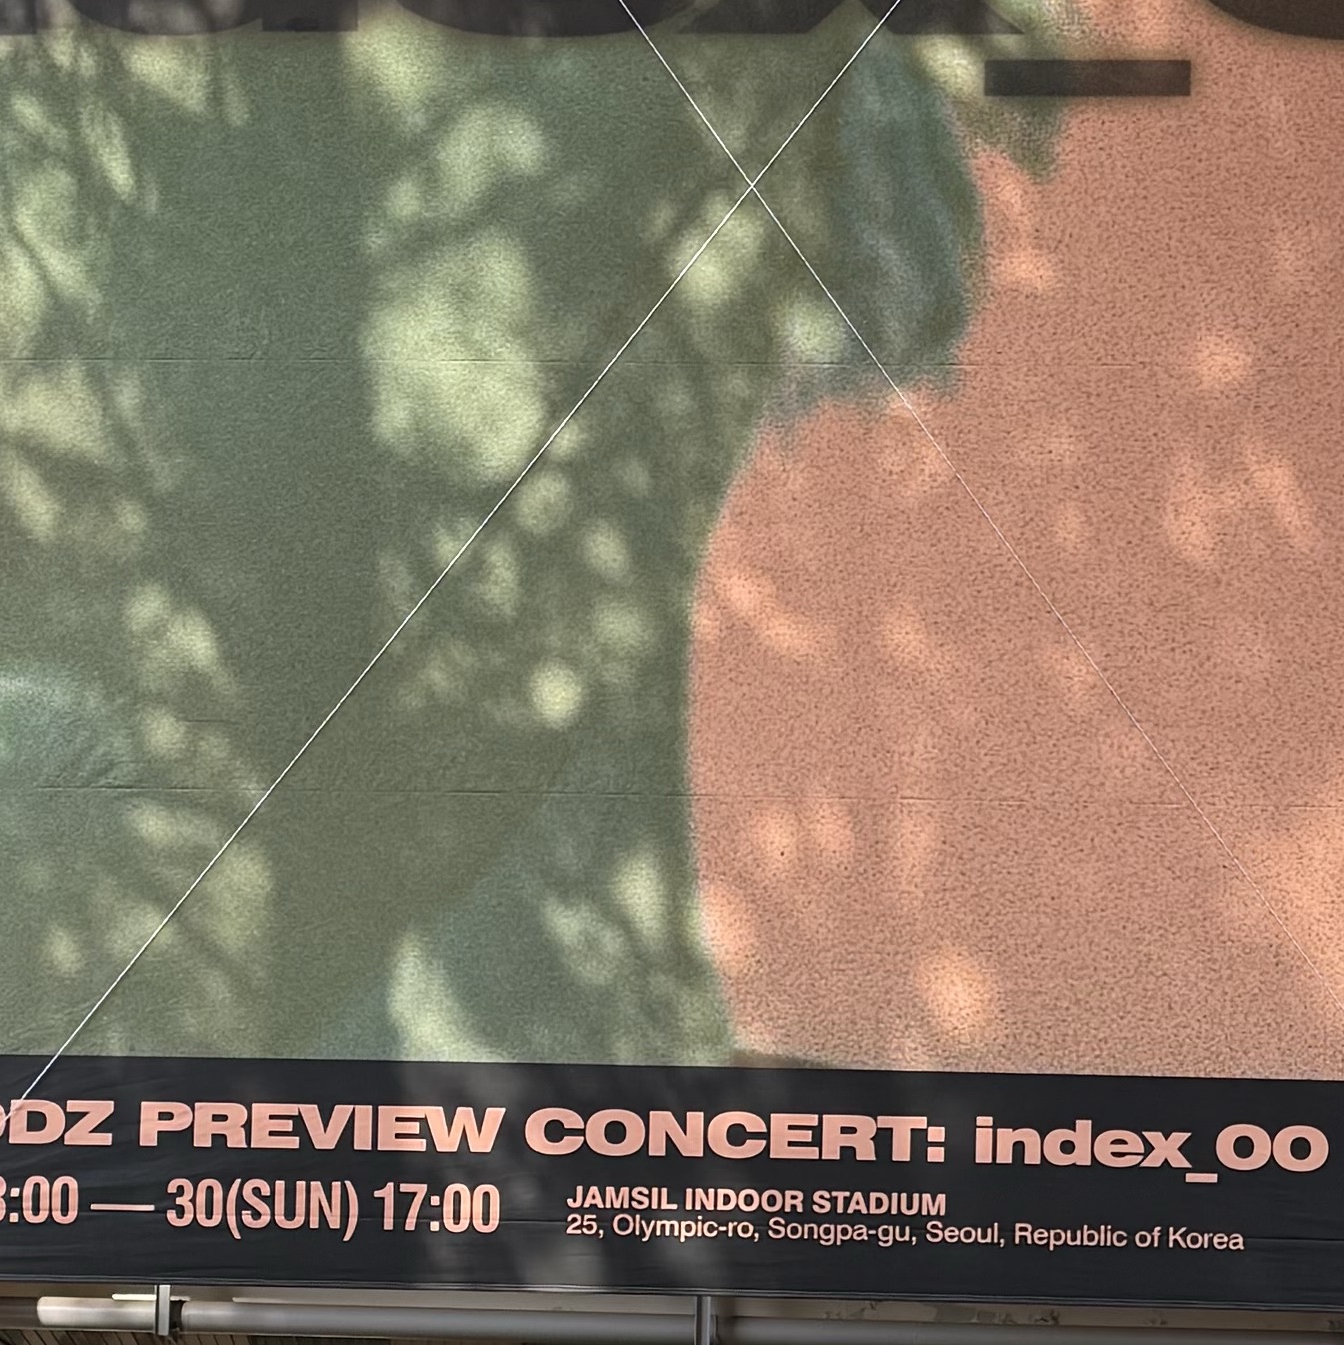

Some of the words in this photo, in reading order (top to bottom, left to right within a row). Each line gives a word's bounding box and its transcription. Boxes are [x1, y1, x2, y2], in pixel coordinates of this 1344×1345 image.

[140, 1101, 506, 1153] PREVIEW
[524, 1107, 945, 1163] CONCERT:
[166, 1178, 359, 1242] 30(SUN)
[374, 1181, 501, 1234] 17:00
[566, 1186, 677, 1211] JAMSIL
[685, 1188, 804, 1214] INDOOR
[812, 1190, 946, 1216] STADIUM
[566, 1214, 604, 1239] 25,
[612, 1215, 760, 1243] Olympic-ro,
[767, 1218, 917, 1247] Songpa-gu,
[925, 1220, 1005, 1247] Seoul,
[1014, 1223, 1127, 1250] Republic
[1134, 1226, 1162, 1248] of
[1168, 1227, 1245, 1250] Korea
